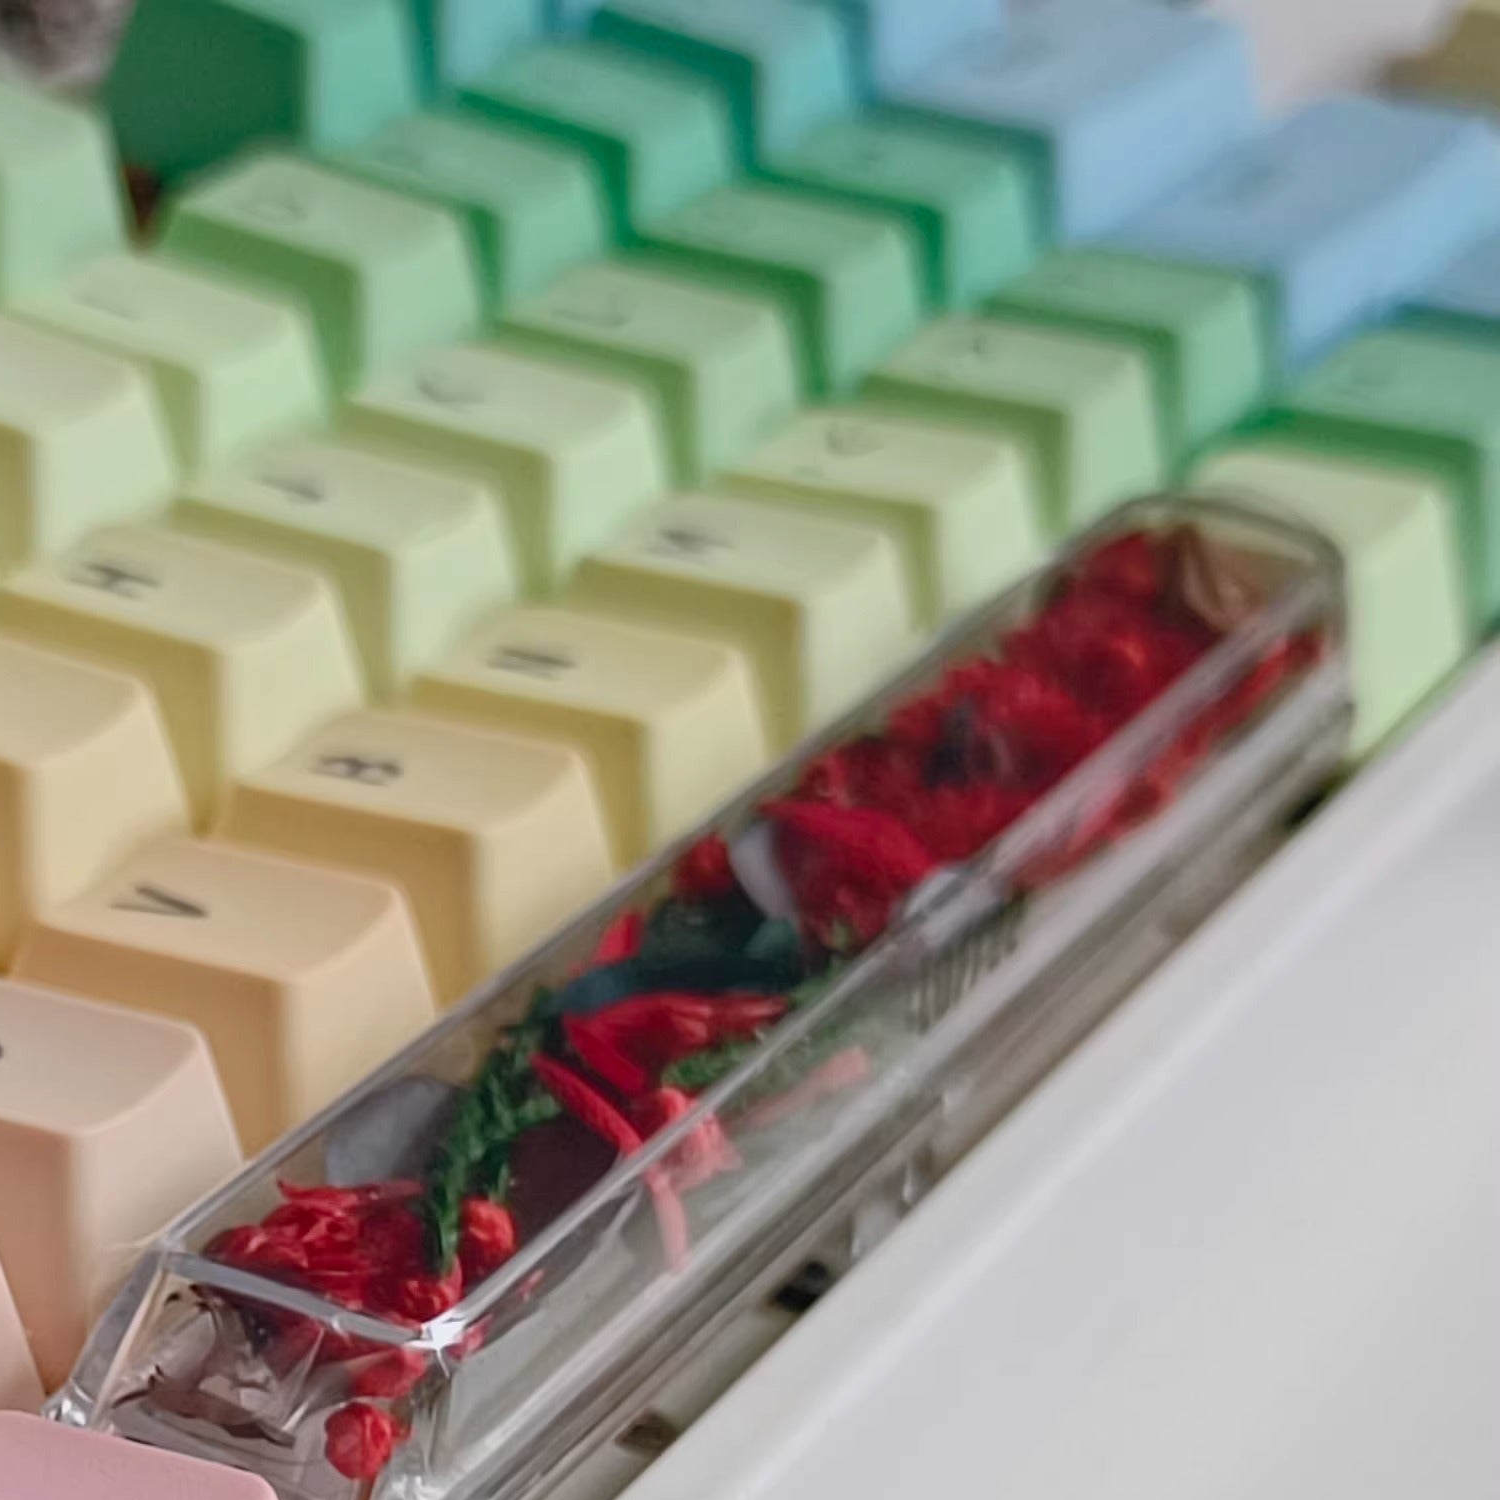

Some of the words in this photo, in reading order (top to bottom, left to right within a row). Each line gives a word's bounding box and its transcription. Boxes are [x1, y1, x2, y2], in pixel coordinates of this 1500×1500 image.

[67, 560, 162, 600] H
[310, 752, 404, 787] B
[108, 884, 209, 919] V
